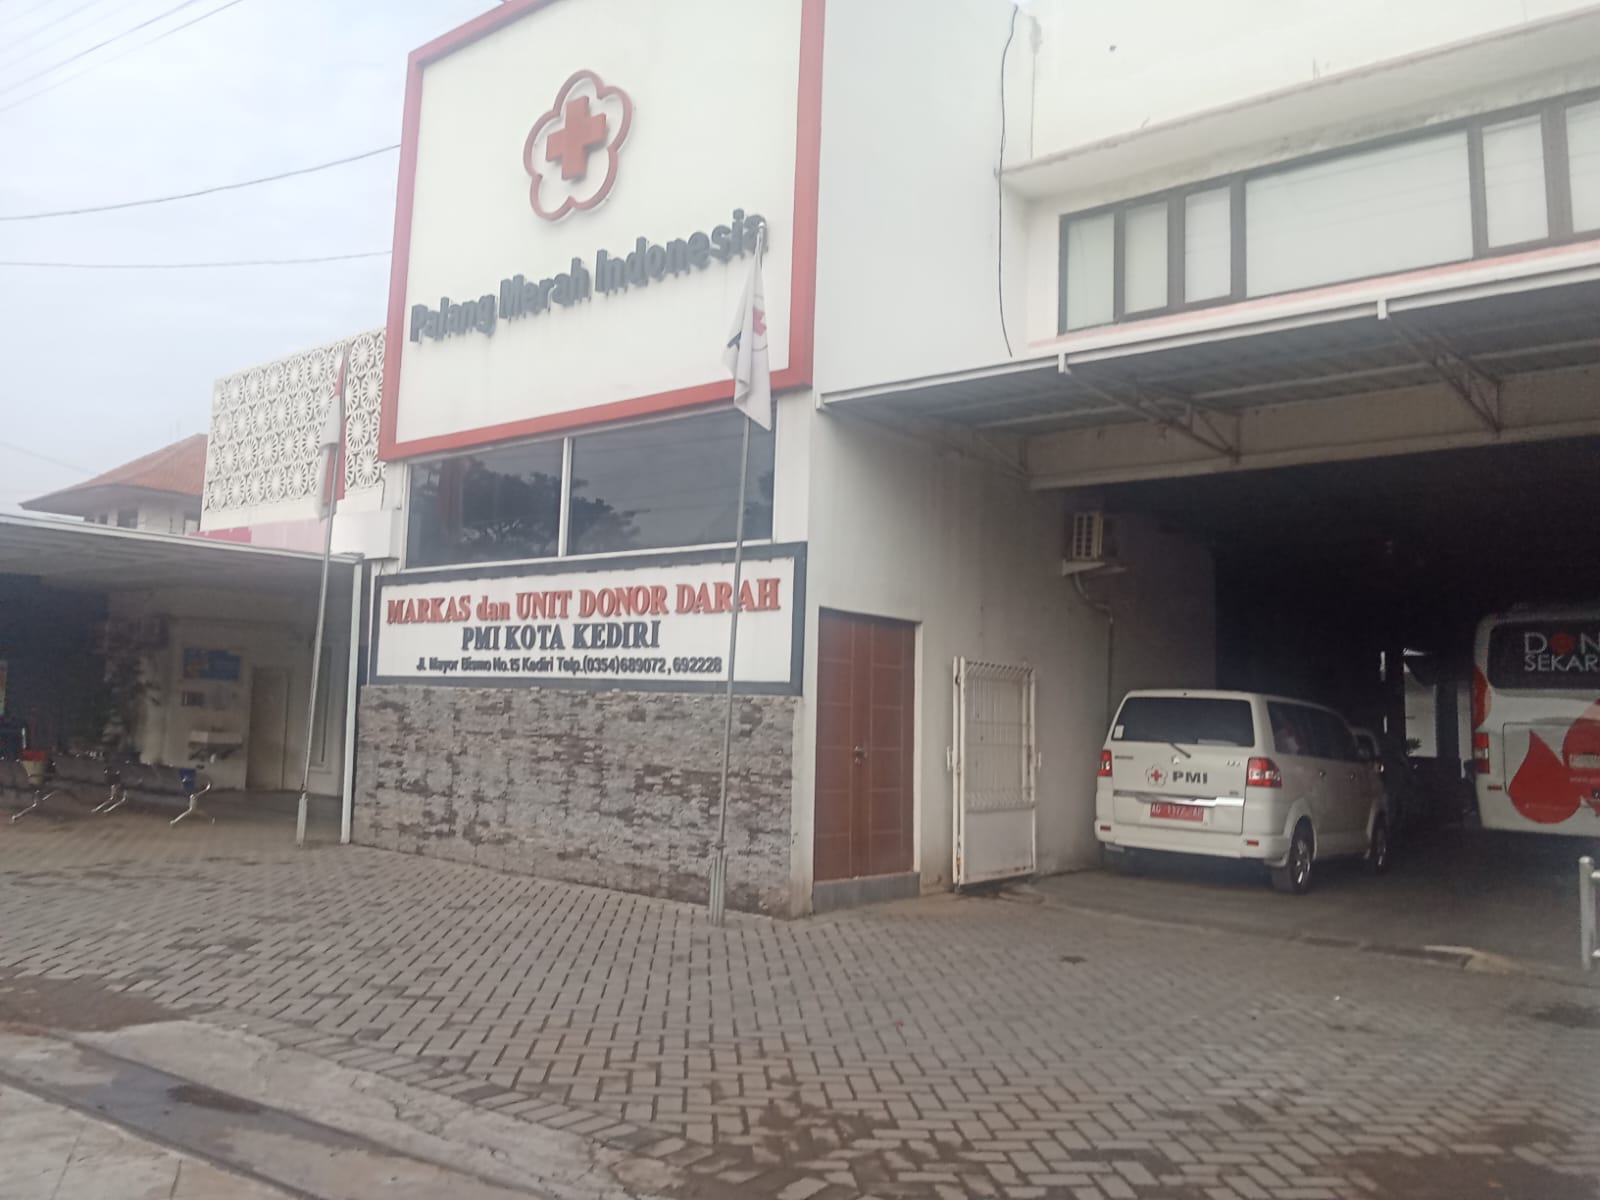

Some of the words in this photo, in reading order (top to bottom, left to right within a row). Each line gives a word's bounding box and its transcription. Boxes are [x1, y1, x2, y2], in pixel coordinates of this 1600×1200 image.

[410, 294, 496, 343] Palang
[499, 256, 591, 323] Merah
[595, 208, 767, 296] Indonesia
[387, 595, 471, 625] MARKAS
[476, 596, 511, 621] dan
[516, 590, 573, 620] UNIT
[578, 585, 669, 618] DONOR
[675, 578, 781, 614] DARAH
[461, 626, 500, 651] PMI
[504, 624, 565, 651] KOTA
[572, 620, 661, 650] KEDIRI
[429, 657, 459, 674] Mayor
[522, 656, 554, 673] Kediri
[1172, 771, 1208, 785] PMI
